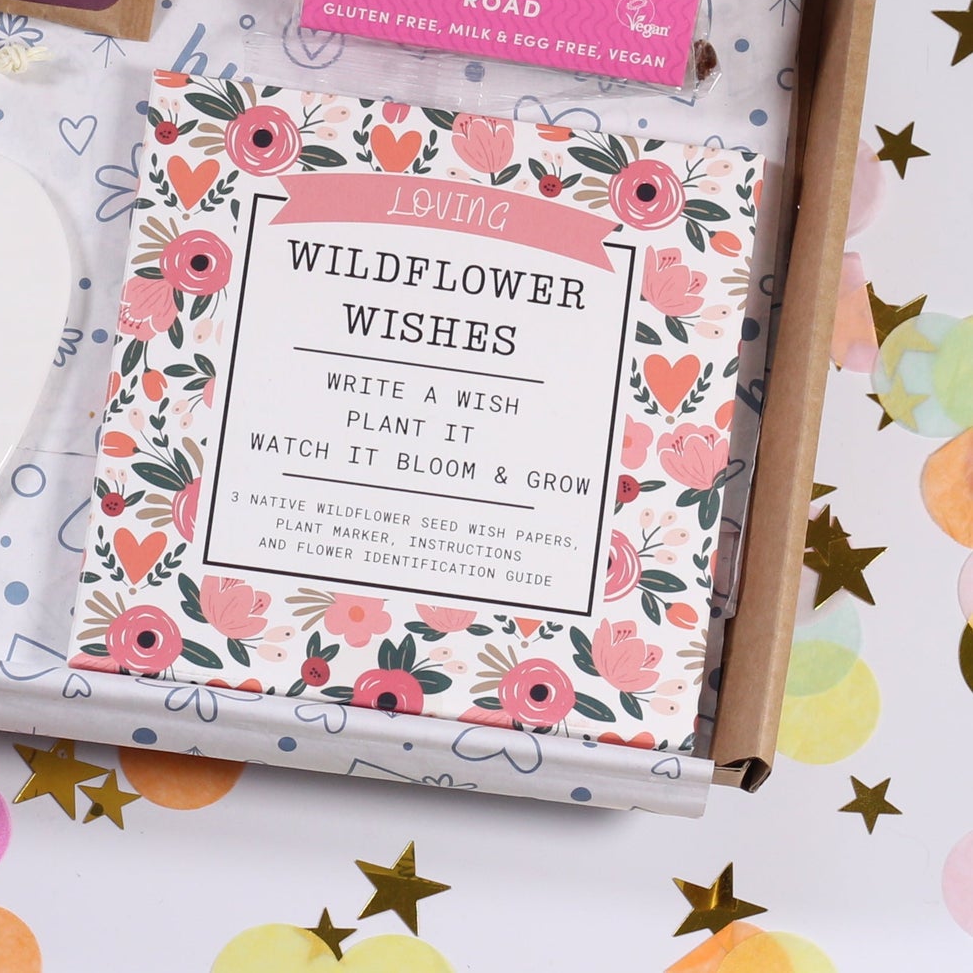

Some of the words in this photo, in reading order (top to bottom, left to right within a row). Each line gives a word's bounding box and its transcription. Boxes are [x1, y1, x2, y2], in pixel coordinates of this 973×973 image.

[323, 2, 389, 24] GLUTEN
[396, 14, 442, 35] FREE,
[449, 23, 491, 41] MILK
[497, 30, 508, 43] &
[514, 31, 550, 50] EGG
[556, 39, 602, 60] FREE,
[608, 49, 666, 68] VEGAN
[287, 239, 585, 311] WILDFLOWER
[343, 303, 517, 357] WISHES
[327, 371, 405, 400] WRITE
[425, 386, 437, 404] A
[457, 389, 520, 415] WISH
[347, 410, 425, 437] PLANT
[445, 423, 475, 444] IT
[250, 433, 329, 460] WATCH
[348, 446, 378, 467] IT
[397, 452, 476, 481] BLOOM
[494, 466, 508, 485] &
[527, 470, 591, 496] GROW
[231, 491, 239, 503] 3
[250, 493, 306, 513] NATIVE
[317, 503, 411, 527] WILDFLOWER
[421, 517, 458, 532] SEED
[468, 523, 506, 539] WISH
[516, 530, 579, 551] PAPERS,
[276, 518, 323, 534] PLANT
[333, 526, 396, 547] MARKER,
[409, 536, 522, 562] INSTRUCTIONS
[258, 536, 288, 550] AND
[297, 541, 354, 559] FLOWER
[364, 550, 496, 579] IDENTIFICATION
[506, 570, 552, 587] GUIDE
